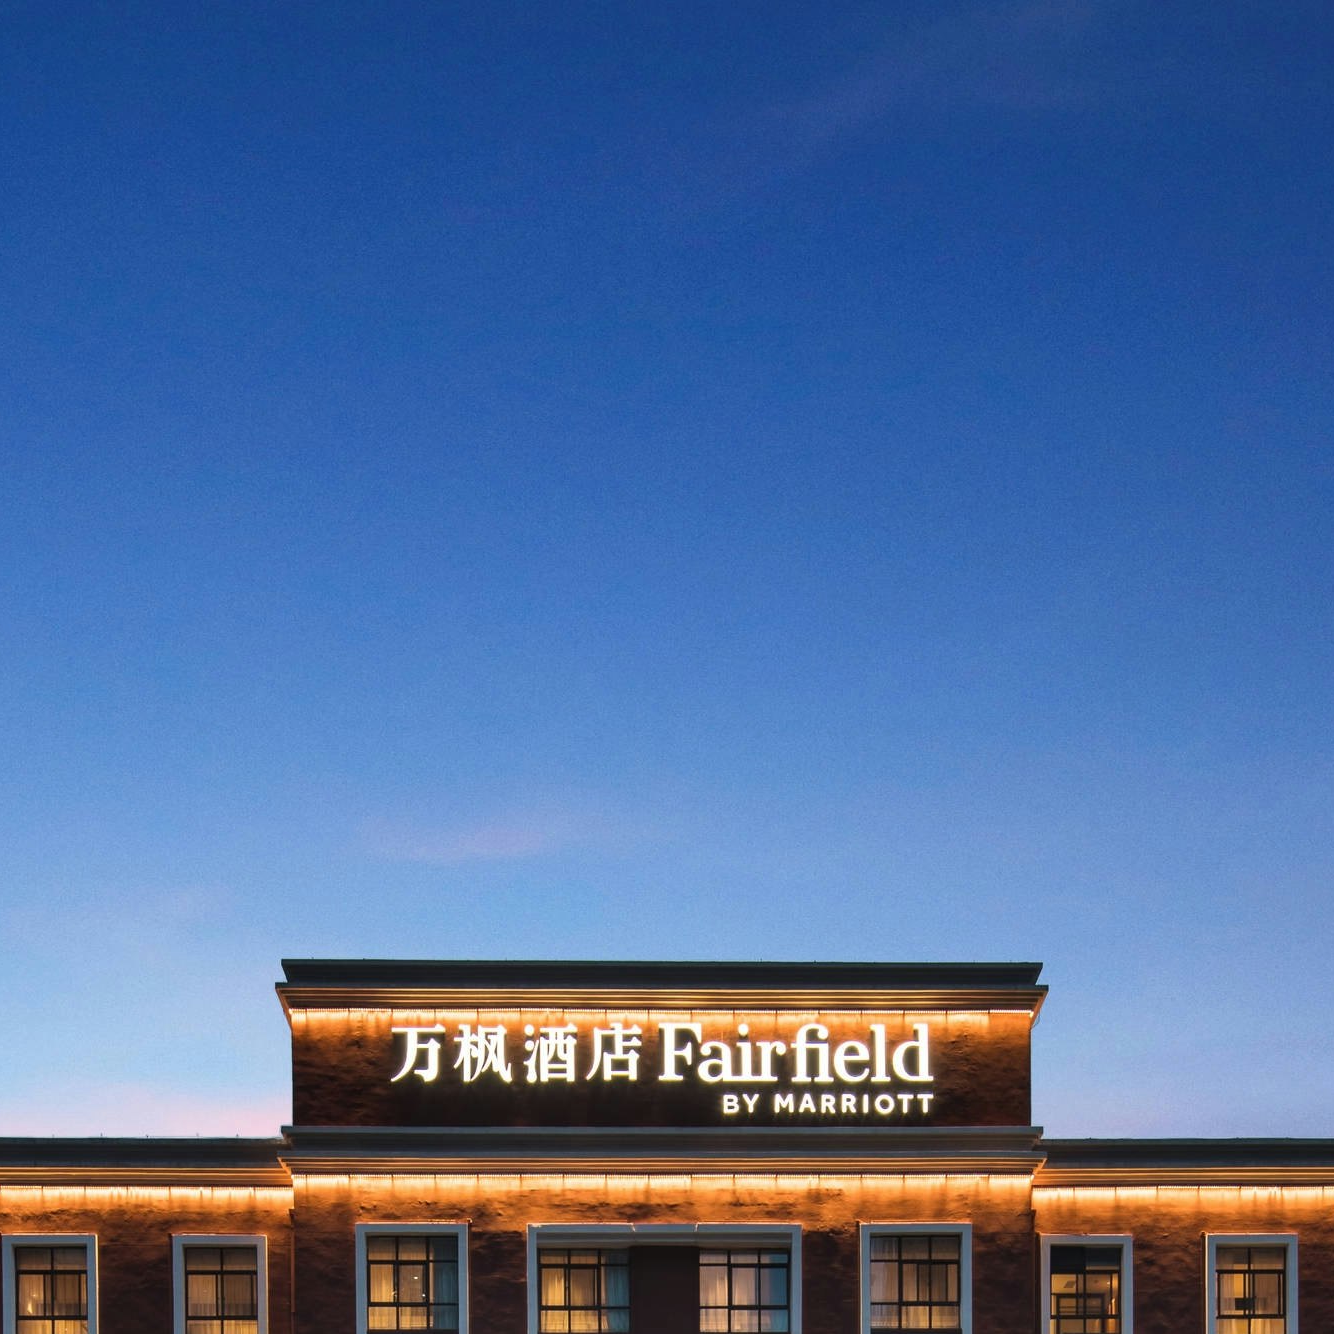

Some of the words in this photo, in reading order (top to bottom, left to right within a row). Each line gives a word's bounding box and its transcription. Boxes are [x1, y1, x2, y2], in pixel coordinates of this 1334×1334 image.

[390, 1022, 642, 1083] 万枫酒店
[658, 1022, 934, 1083] Fairfield
[722, 1093, 760, 1114] BY
[774, 1093, 934, 1115] MARRIOTT
